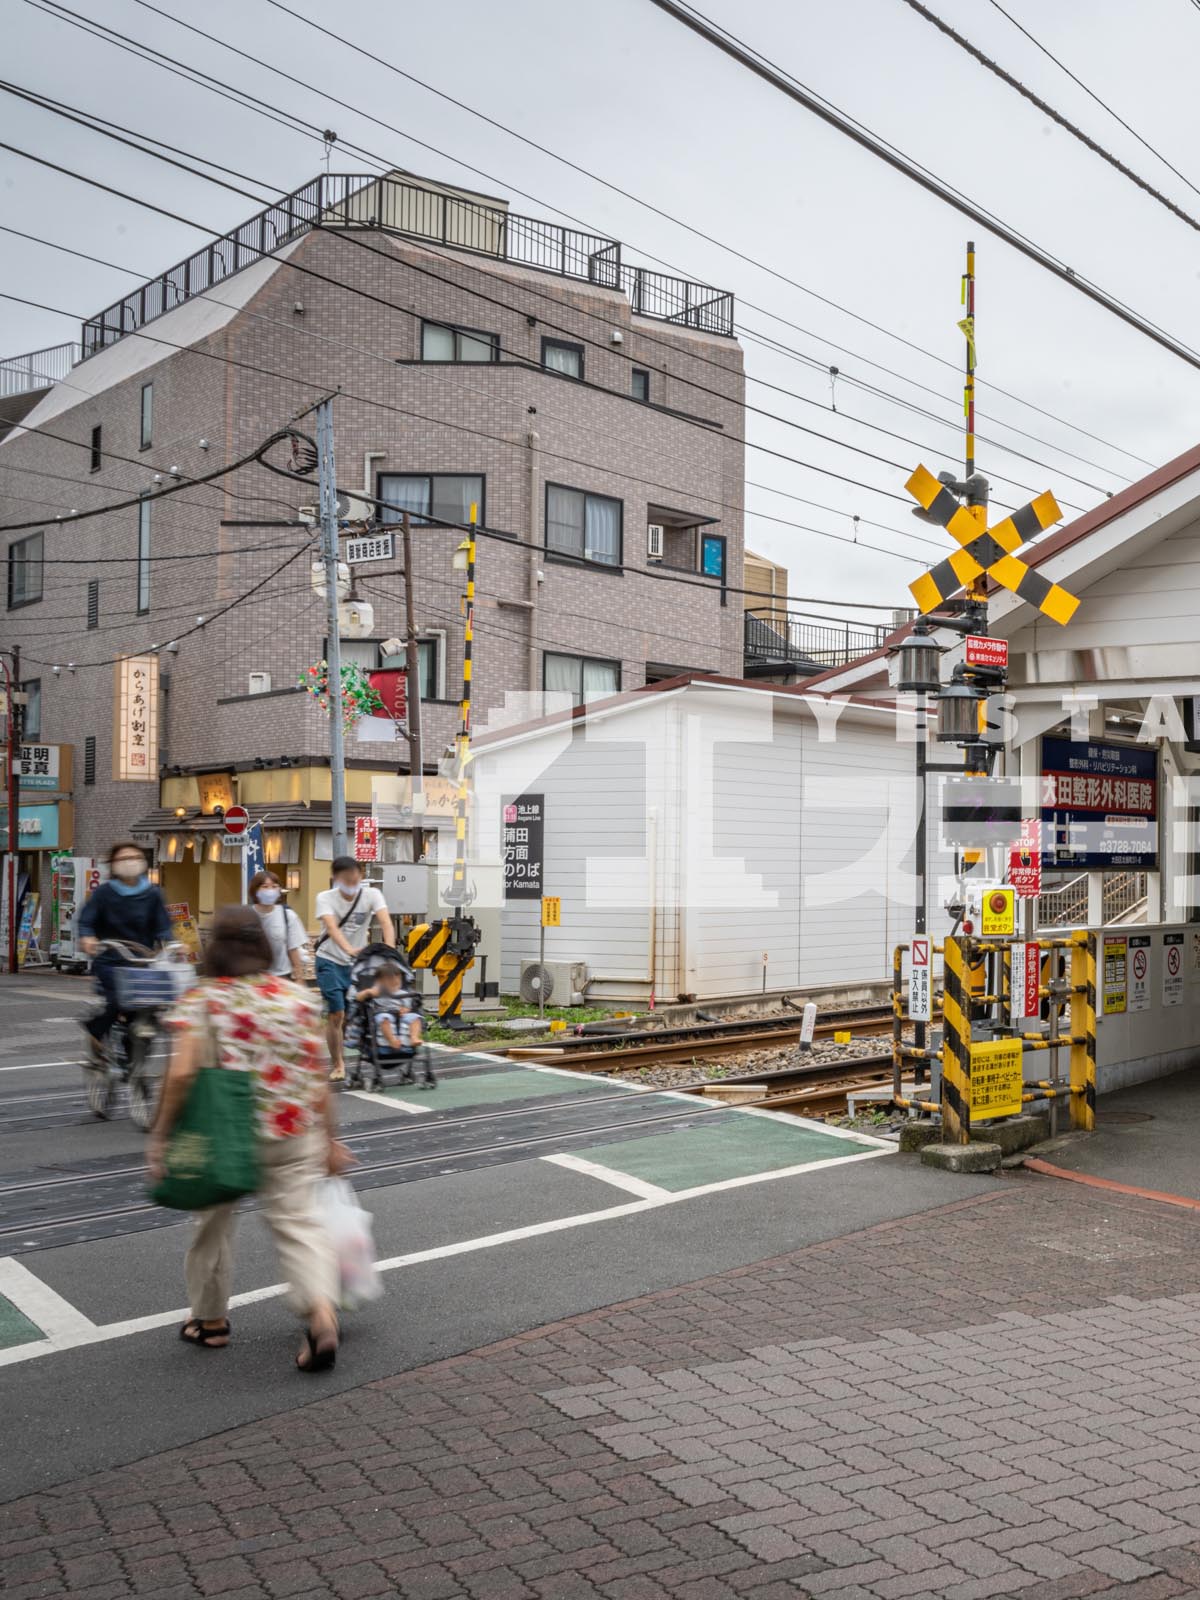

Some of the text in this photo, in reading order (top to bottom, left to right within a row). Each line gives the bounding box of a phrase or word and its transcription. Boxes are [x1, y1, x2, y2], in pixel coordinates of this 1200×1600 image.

[1043, 773, 1152, 811] 大田整形外科医院
[518, 805, 540, 815] 池上線
[503, 828, 529, 843] 蒲田
[1014, 838, 1035, 847] STOP
[503, 845, 529, 860] 方面
[503, 862, 541, 877] のりば
[1012, 867, 1038, 876] 非常停止
[513, 880, 540, 889] Kamata
[1015, 875, 1035, 884] ボタン
[1027, 947, 1037, 1013] 非常ボタン
